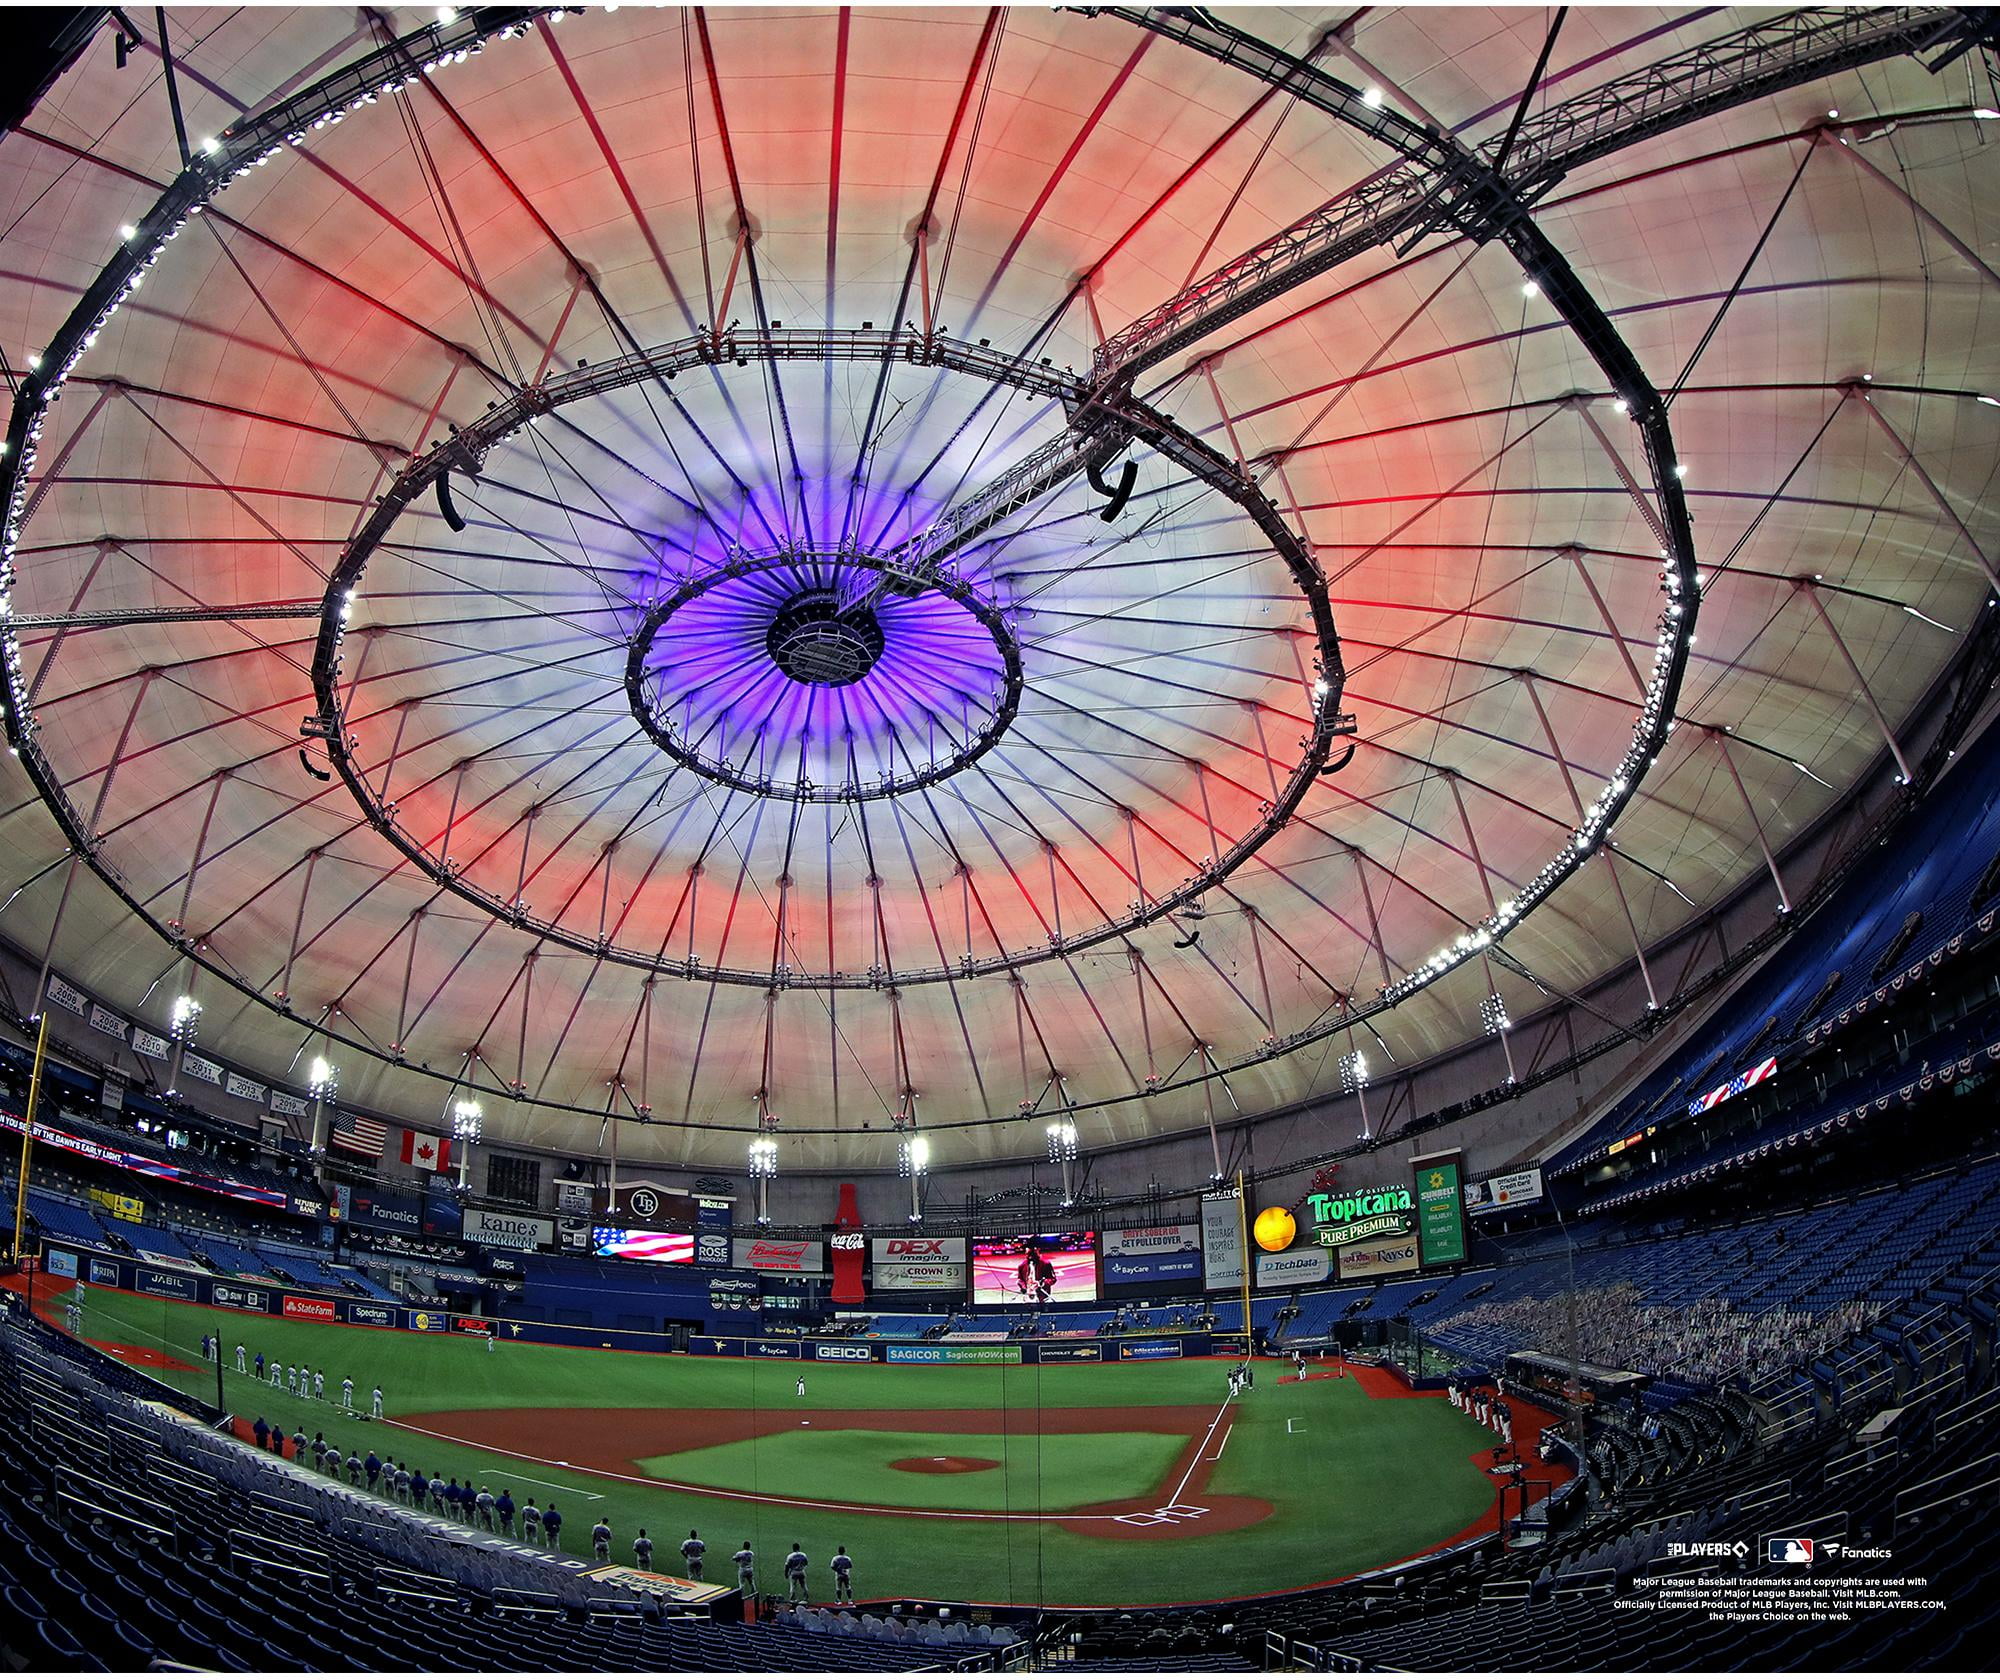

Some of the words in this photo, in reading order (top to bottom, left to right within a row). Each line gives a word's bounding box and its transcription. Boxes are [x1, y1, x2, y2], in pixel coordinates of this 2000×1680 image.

[56, 987, 77, 1004] 2008
[99, 1014, 119, 1030] 2008
[141, 1038, 161, 1051] 2010
[192, 1061, 212, 1076] 2011
[236, 1081, 256, 1094] 2013
[279, 1098, 297, 1109] 2019
[5, 1115, 18, 1128] YOU
[33, 1126, 42, 1138] BY
[42, 1130, 55, 1141] THE
[81, 1143, 103, 1156] EARLY
[1366, 1184, 1405, 1195] ORIGINAL
[299, 1206, 317, 1215] BANK
[1308, 1189, 1411, 1222] Tropicana
[372, 1205, 419, 1224] Fanatics
[480, 1213, 538, 1236] kanes
[1320, 1230, 1348, 1243] PURE
[1349, 1217, 1399, 1238] PREMIUM
[1144, 1227, 1168, 1237] SOBER
[1208, 1228, 1235, 1239] COURAGE
[887, 1240, 945, 1254] DEX
[1121, 1239, 1136, 1248] GET
[1136, 1237, 1162, 1247] PULLED
[1163, 1236, 1181, 1244] OVER
[1208, 1240, 1235, 1251] INSPIRES
[699, 1247, 728, 1257] ROSE
[1404, 1246, 1414, 1258] 6
[98, 1267, 116, 1279] RIPA
[907, 1267, 943, 1276] CROWN
[1122, 1265, 1149, 1274] BayCare
[151, 1274, 184, 1288] JABIL
[355, 1306, 388, 1319] Spectrum
[457, 1319, 490, 1330] DEX
[818, 1347, 870, 1359] GEICO
[890, 1351, 941, 1360] SAGICOR
[945, 1351, 1018, 1361] SagicorNOW.com
[481, 1540, 588, 1569] FIELD
[615, 1571, 693, 1593] Tropicana
